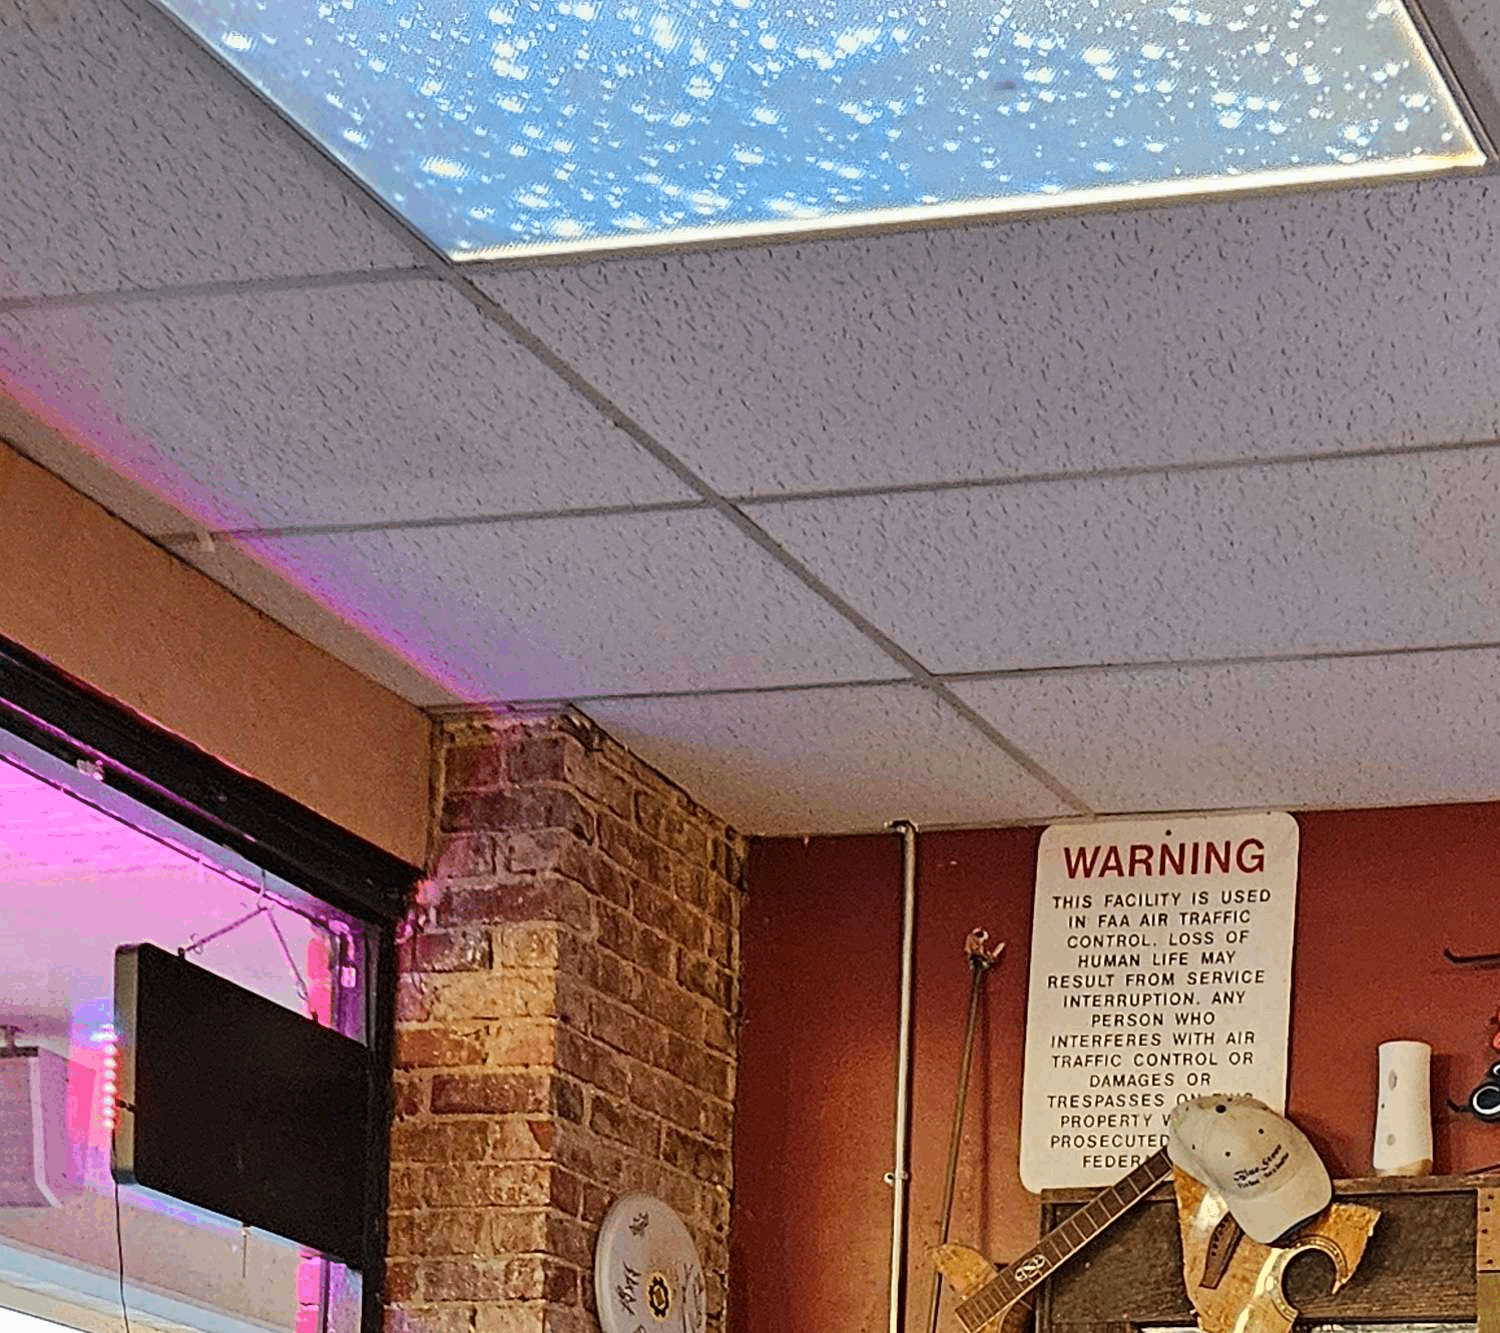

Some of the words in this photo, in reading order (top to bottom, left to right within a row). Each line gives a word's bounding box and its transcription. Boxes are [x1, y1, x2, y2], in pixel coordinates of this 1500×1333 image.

[1063, 838, 1265, 879] WARNING
[1052, 896, 1093, 910] THIS
[1104, 892, 1182, 908] FACILITY
[1192, 891, 1209, 905] IS
[1221, 889, 1272, 904] USED
[1068, 915, 1087, 929] IN
[1098, 914, 1130, 928] FAA
[1140, 912, 1168, 926] AIR
[1180, 910, 1251, 925] TRAFFIC
[1066, 933, 1157, 949] CONTROL.
[1169, 931, 1215, 946] LOSS
[1226, 930, 1249, 944] OF
[1078, 953, 1141, 968] HUMAN
[1152, 952, 1189, 966] LIFE
[1201, 951, 1236, 965] MAY
[1047, 974, 1115, 989] RESULT
[1126, 972, 1175, 987] FROM
[1186, 970, 1265, 986] SERVICE
[1063, 992, 1200, 1009] INTERRUPTION.
[1211, 991, 1246, 1005] ANY
[1091, 1013, 1164, 1028] PERSON
[1174, 1012, 1216, 1026] WHO
[1051, 1033, 1161, 1049] INTERFERES
[1172, 1032, 1216, 1047] WITH
[1225, 1031, 1255, 1045] AIR
[1052, 1053, 1122, 1069] TRAFFIC
[1133, 1052, 1218, 1067] CONTROL
[1229, 1051, 1254, 1065] OR
[1089, 1073, 1175, 1089] DAMAGES
[1186, 1072, 1211, 1087] OR
[1047, 1093, 1165, 1109] TRESPASSES
[1060, 1114, 1153, 1129] PROPERTY
[1050, 1134, 1170, 1150] PROSECUTED
[1082, 1155, 1152, 1170] FEDER
